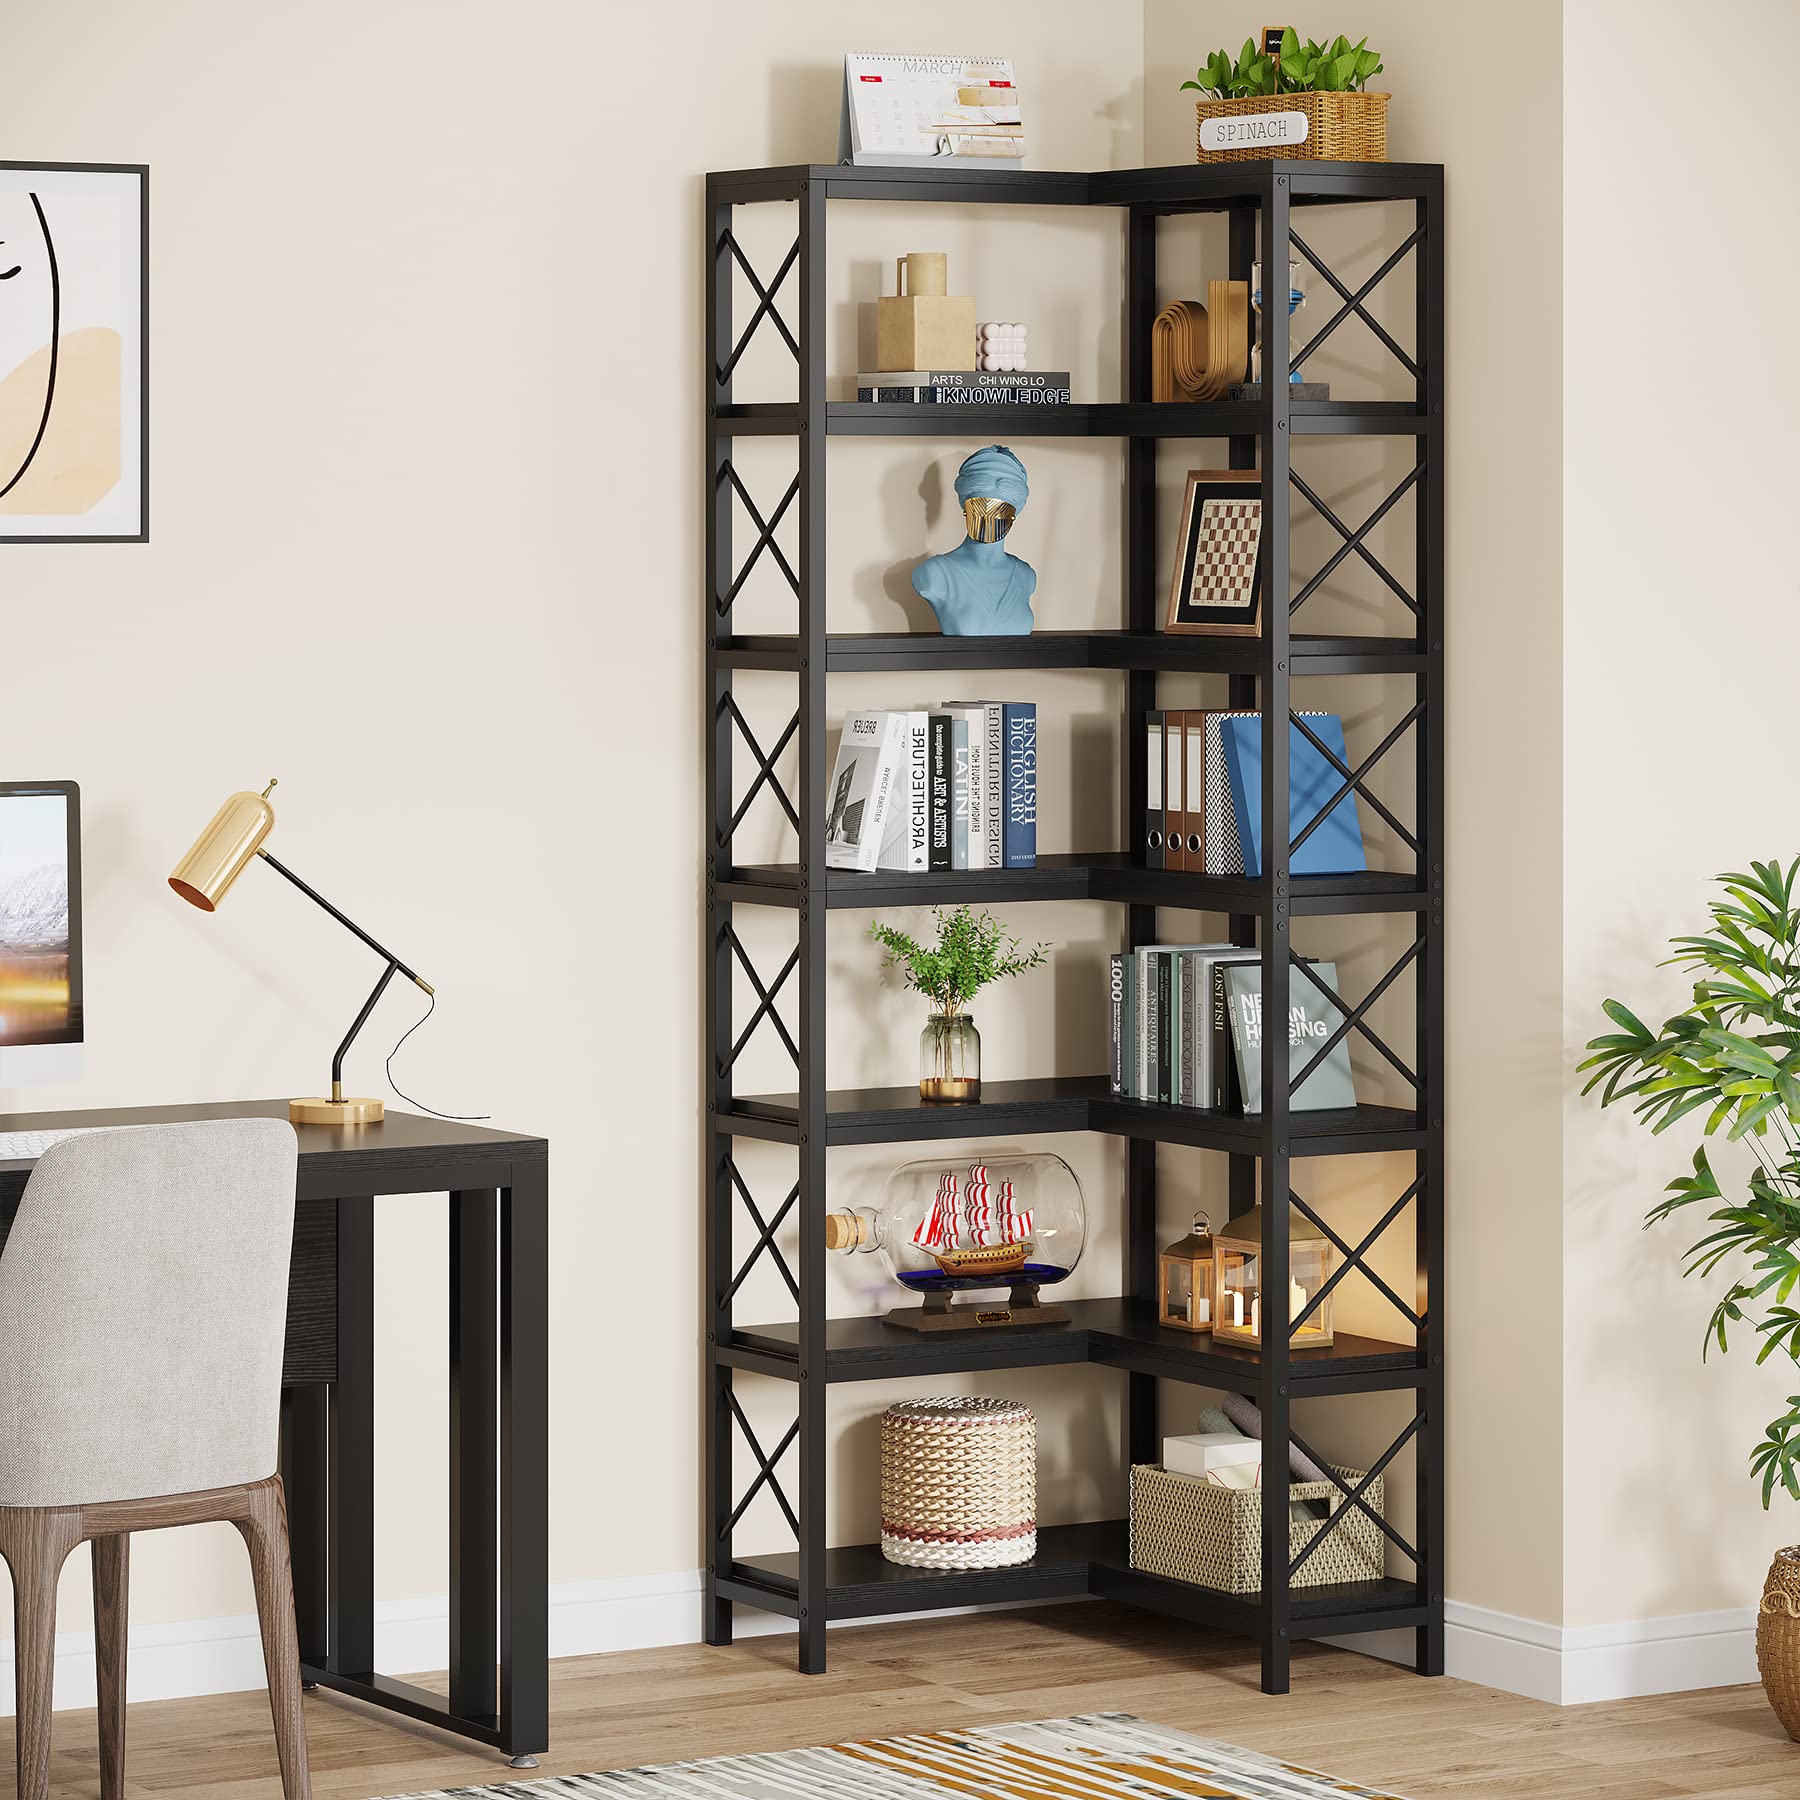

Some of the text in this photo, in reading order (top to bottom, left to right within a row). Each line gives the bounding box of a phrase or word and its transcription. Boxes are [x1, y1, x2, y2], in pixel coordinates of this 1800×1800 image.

[903, 61, 962, 75] MARCH
[1216, 120, 1288, 142] SPINACH
[932, 375, 963, 385] ARTS
[943, 387, 1070, 404] KNOWLEDGE
[979, 376, 1045, 386] CHI WING LO
[1010, 718, 1024, 826] DICTIONARY
[1024, 717, 1036, 825] ENGLISH
[934, 776, 947, 848] ART & ARTISTS
[1111, 960, 1123, 1002] 1000
[1214, 966, 1224, 1031] LOST FISH
[1240, 994, 1262, 1009] NE
[1182, 956, 1192, 1097] ALEXEY BRODOVITCH
